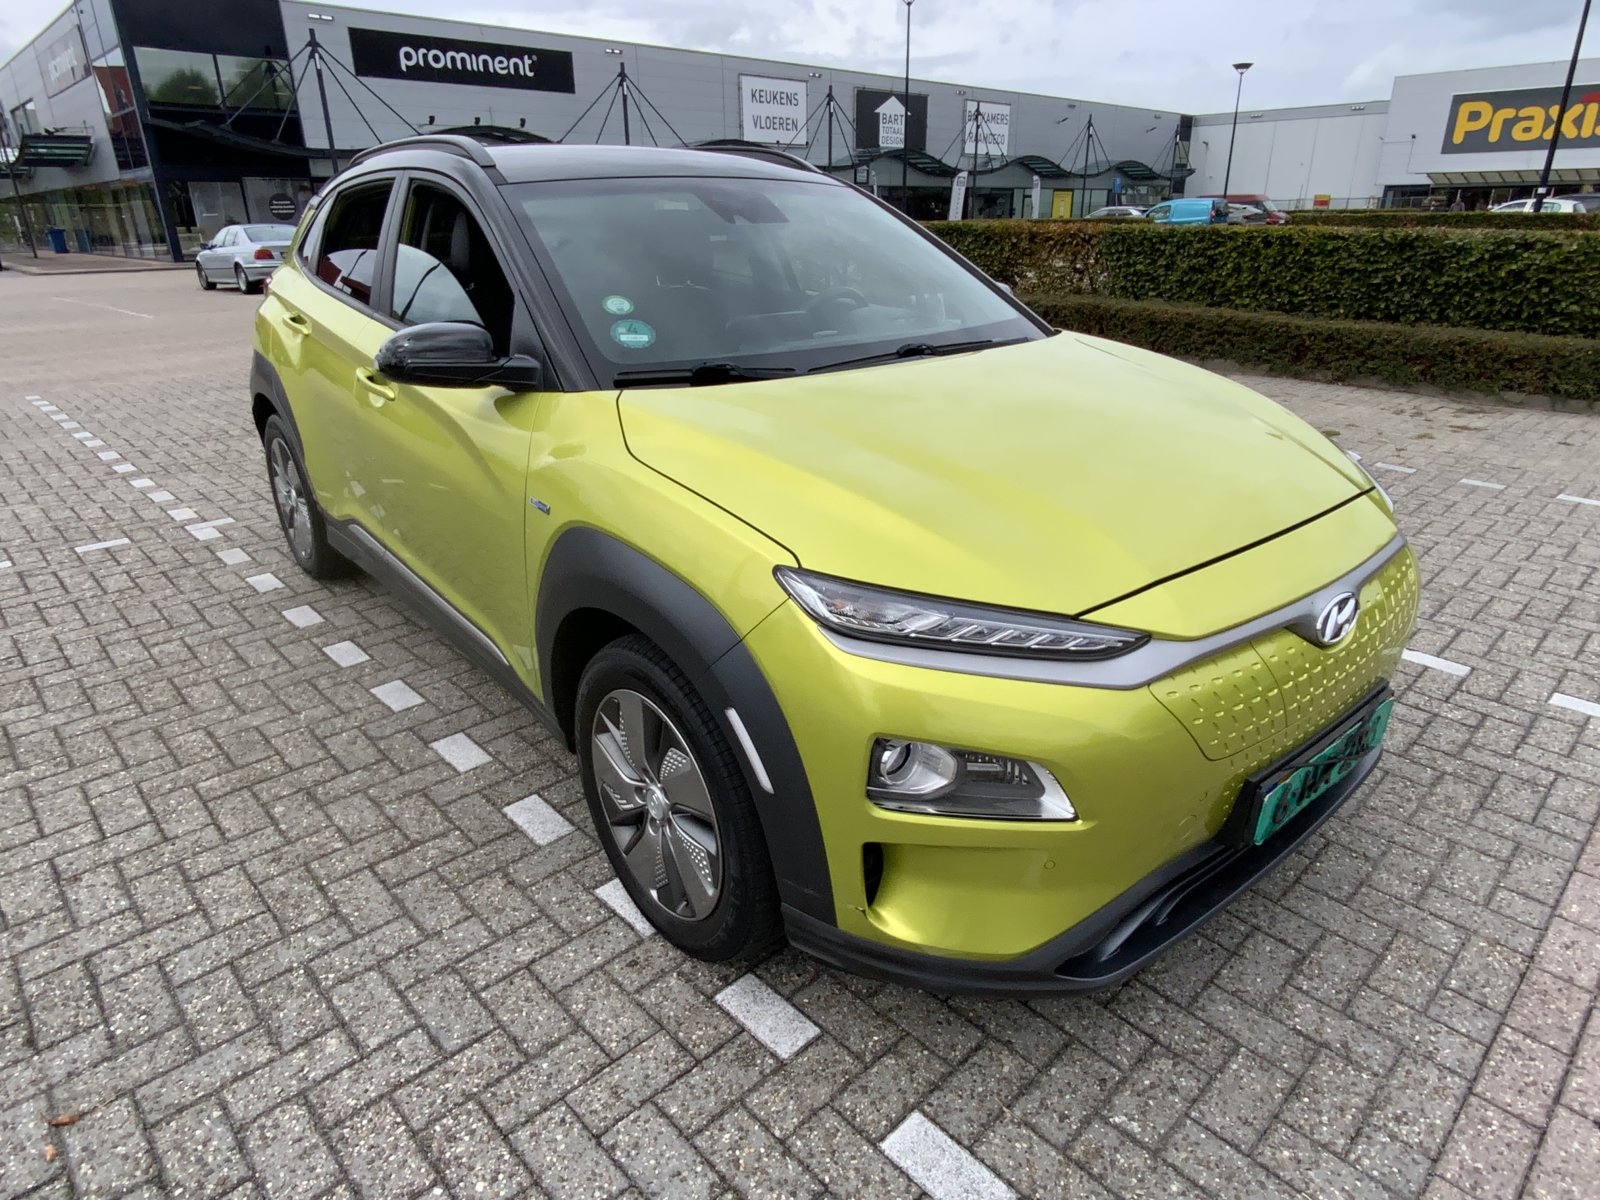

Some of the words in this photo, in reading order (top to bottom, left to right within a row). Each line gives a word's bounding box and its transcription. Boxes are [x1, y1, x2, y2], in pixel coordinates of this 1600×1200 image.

[751, 88, 799, 106] KEUKENS
[752, 114, 798, 132] VLOEREN
[881, 113, 904, 125] BART
[1452, 101, 1600, 144] Praxi
[881, 136, 904, 145] DESIGN
